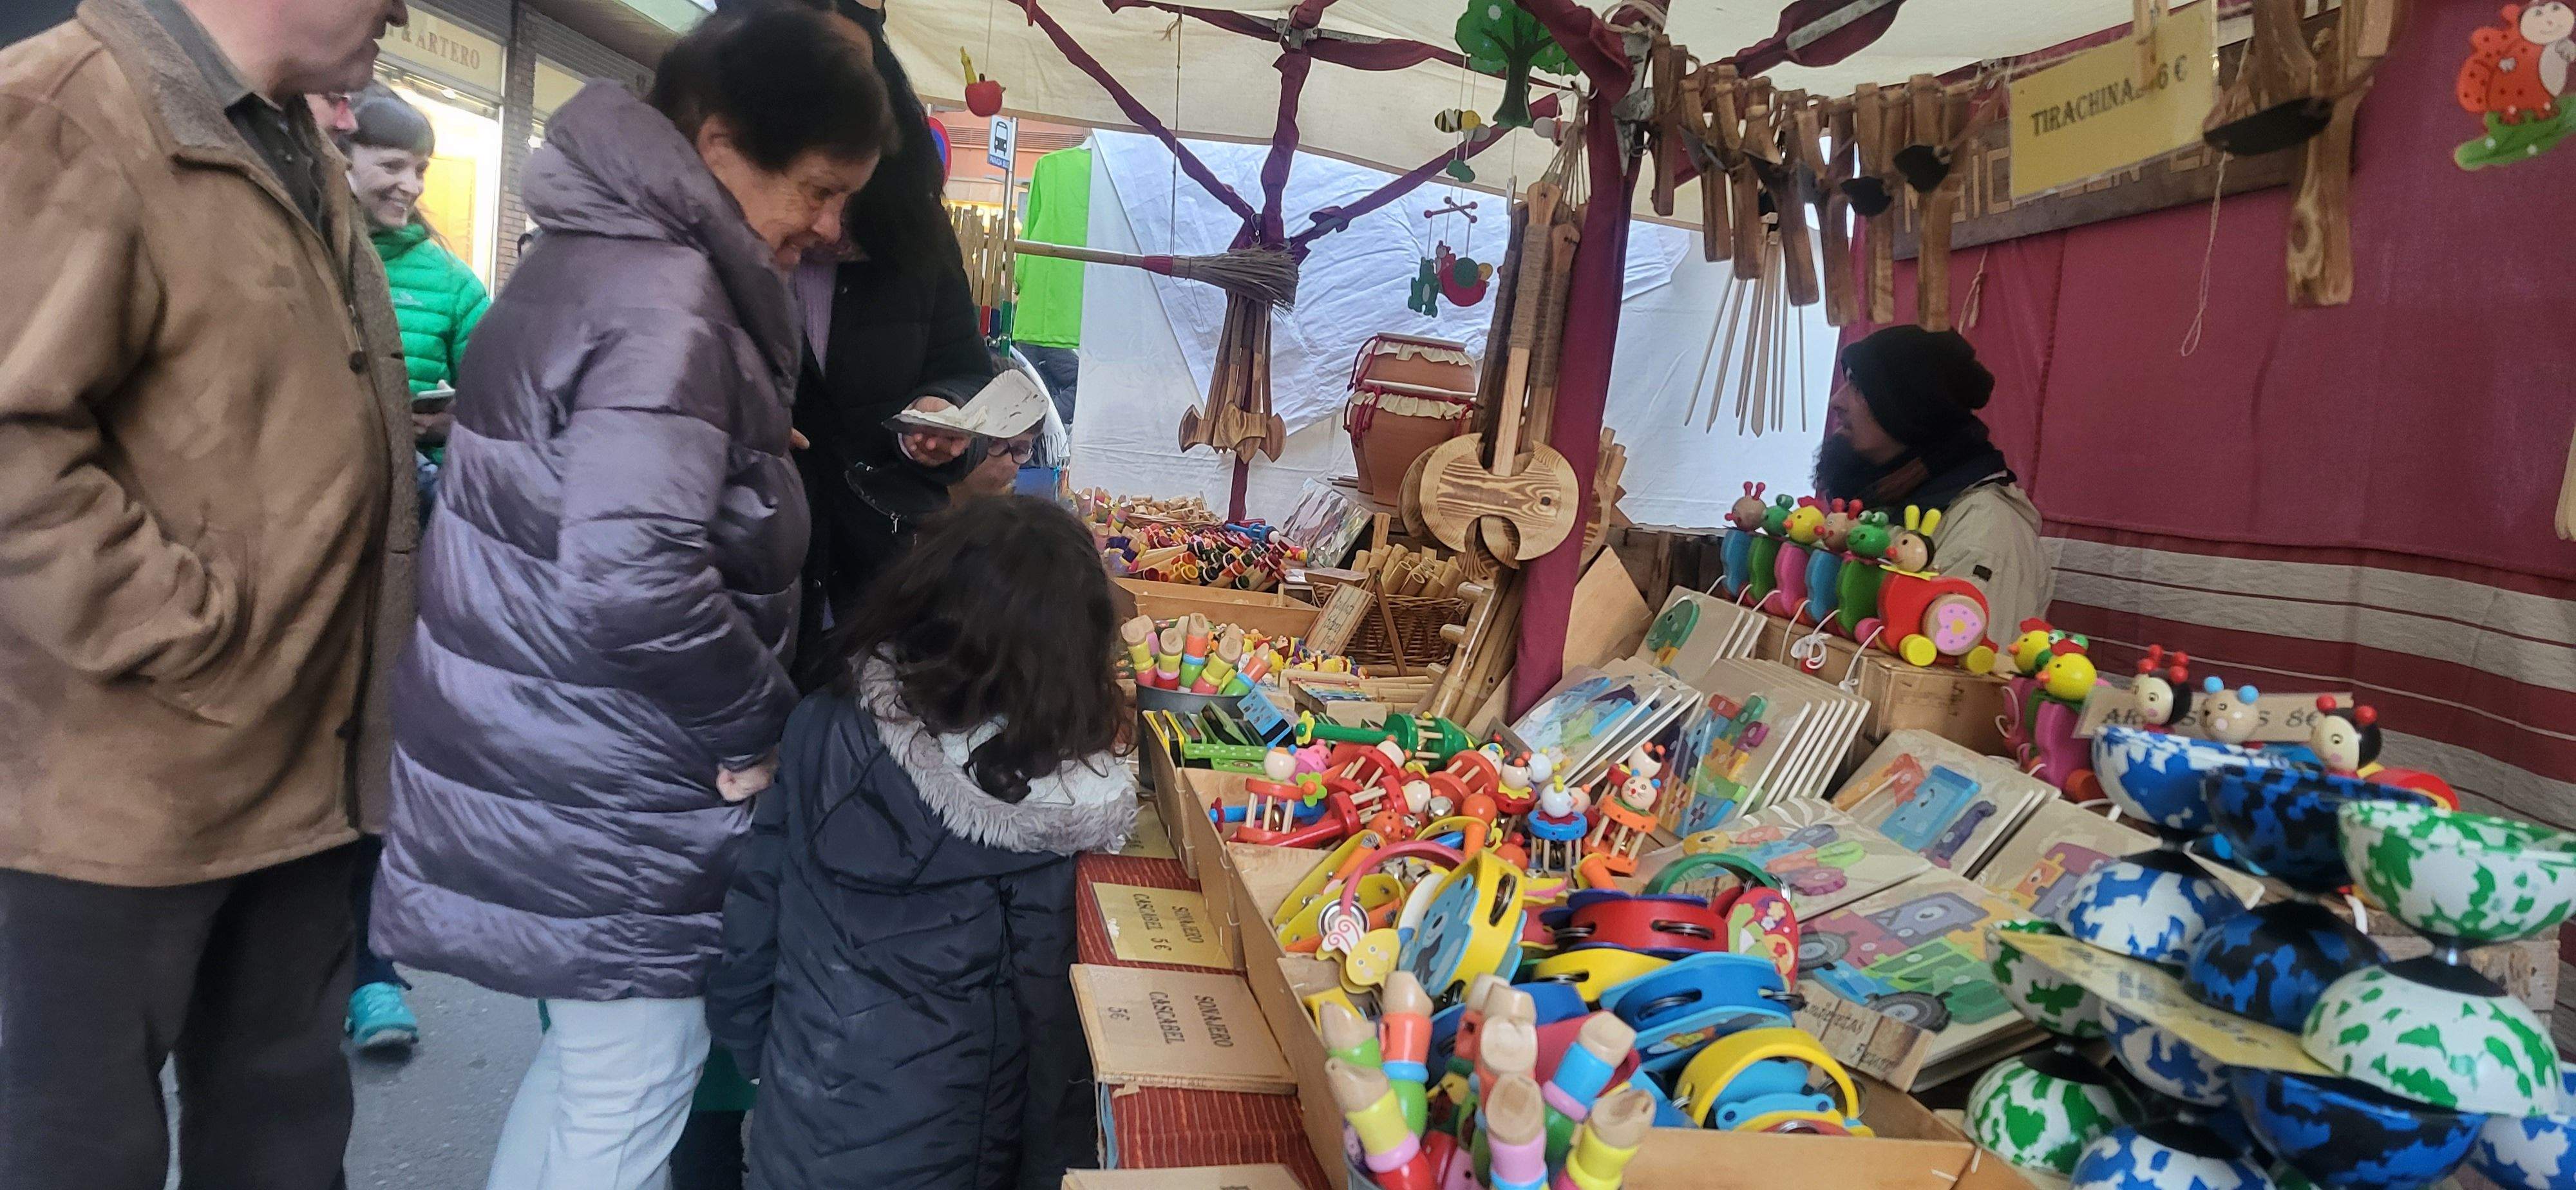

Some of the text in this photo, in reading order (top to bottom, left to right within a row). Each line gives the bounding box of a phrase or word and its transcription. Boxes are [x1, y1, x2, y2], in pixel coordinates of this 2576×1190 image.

[415, 32, 480, 70] ARTERO
[1132, 892, 1163, 930] CASCABEL
[1171, 906, 1204, 944] SONAJERO
[1107, 1006, 1130, 1021] 5€
[1148, 991, 1185, 1045] CASCABEL
[1194, 995, 1234, 1048] SONAJERO
